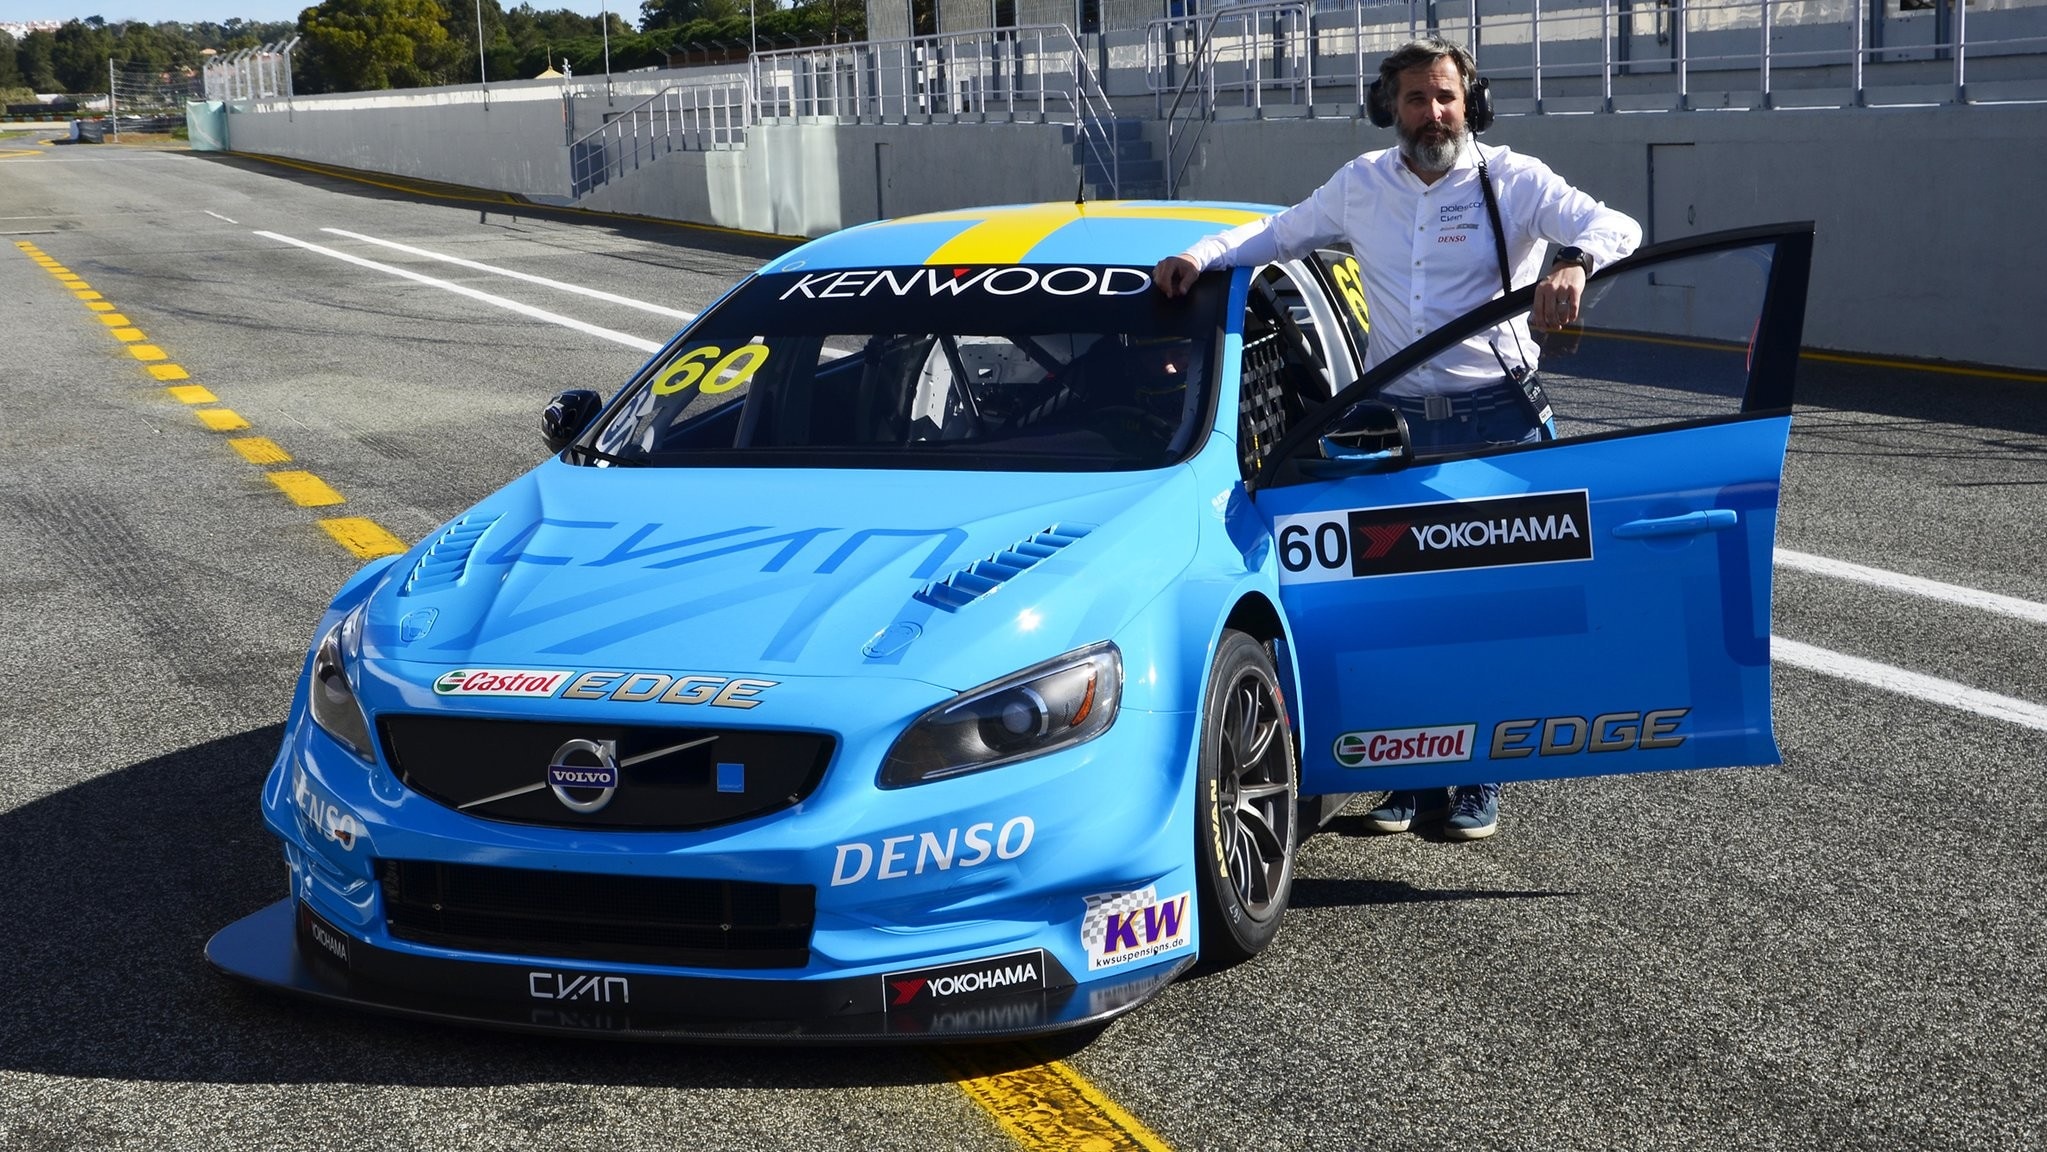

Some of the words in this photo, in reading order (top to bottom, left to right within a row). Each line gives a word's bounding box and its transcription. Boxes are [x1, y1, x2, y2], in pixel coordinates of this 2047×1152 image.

[1438, 235, 1467, 243] DENSO
[779, 267, 1152, 301] KENWOOD
[653, 344, 770, 396] 60
[485, 518, 968, 580] CYAN
[1278, 521, 1348, 573] 60
[1411, 514, 1580, 551] YOKOHAMA
[462, 671, 561, 697] Castrol
[560, 671, 782, 710] EDGE
[1368, 728, 1465, 762] Castrol
[1488, 706, 1692, 760] EDGE
[552, 770, 611, 783] VOLVO
[1210, 779, 1229, 878] ADVAN
[830, 815, 1036, 887] DENSO
[1104, 895, 1189, 955] KW
[1096, 938, 1184, 967] kwsuspensions.de
[529, 972, 630, 1004] CYAN
[926, 963, 1038, 998] YOKOHAMA
